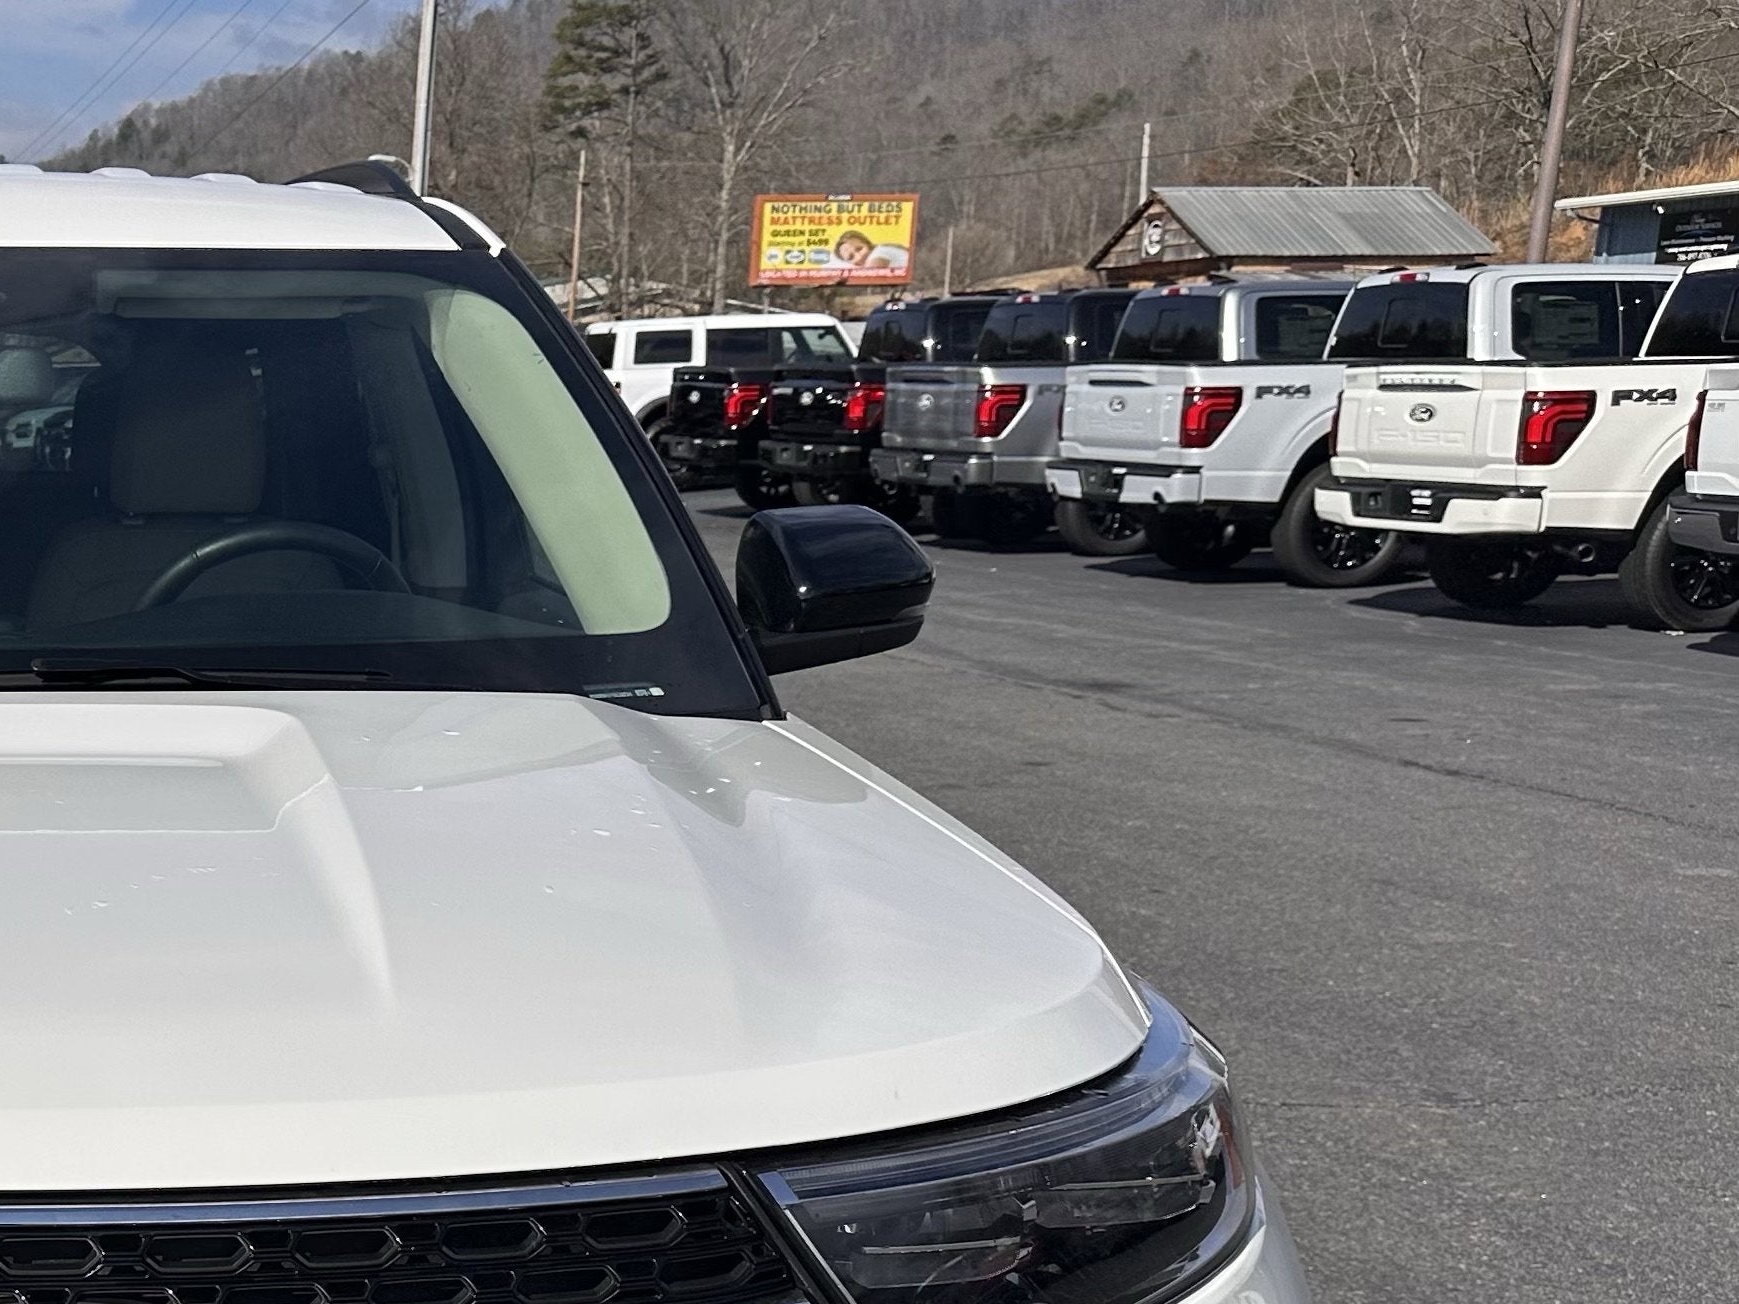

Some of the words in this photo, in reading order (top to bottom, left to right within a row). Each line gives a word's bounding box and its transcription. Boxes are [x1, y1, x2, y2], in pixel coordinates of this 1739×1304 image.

[771, 203, 832, 214] NOTHING
[837, 203, 863, 213] BUT
[868, 202, 902, 213] BEDS
[770, 215, 843, 226] MATTRESS
[847, 214, 902, 225] OUTLET
[770, 229, 805, 237] QUEEN
[808, 229, 827, 237] SET
[1255, 384, 1310, 399] FX4
[1611, 388, 1677, 406] FX4
